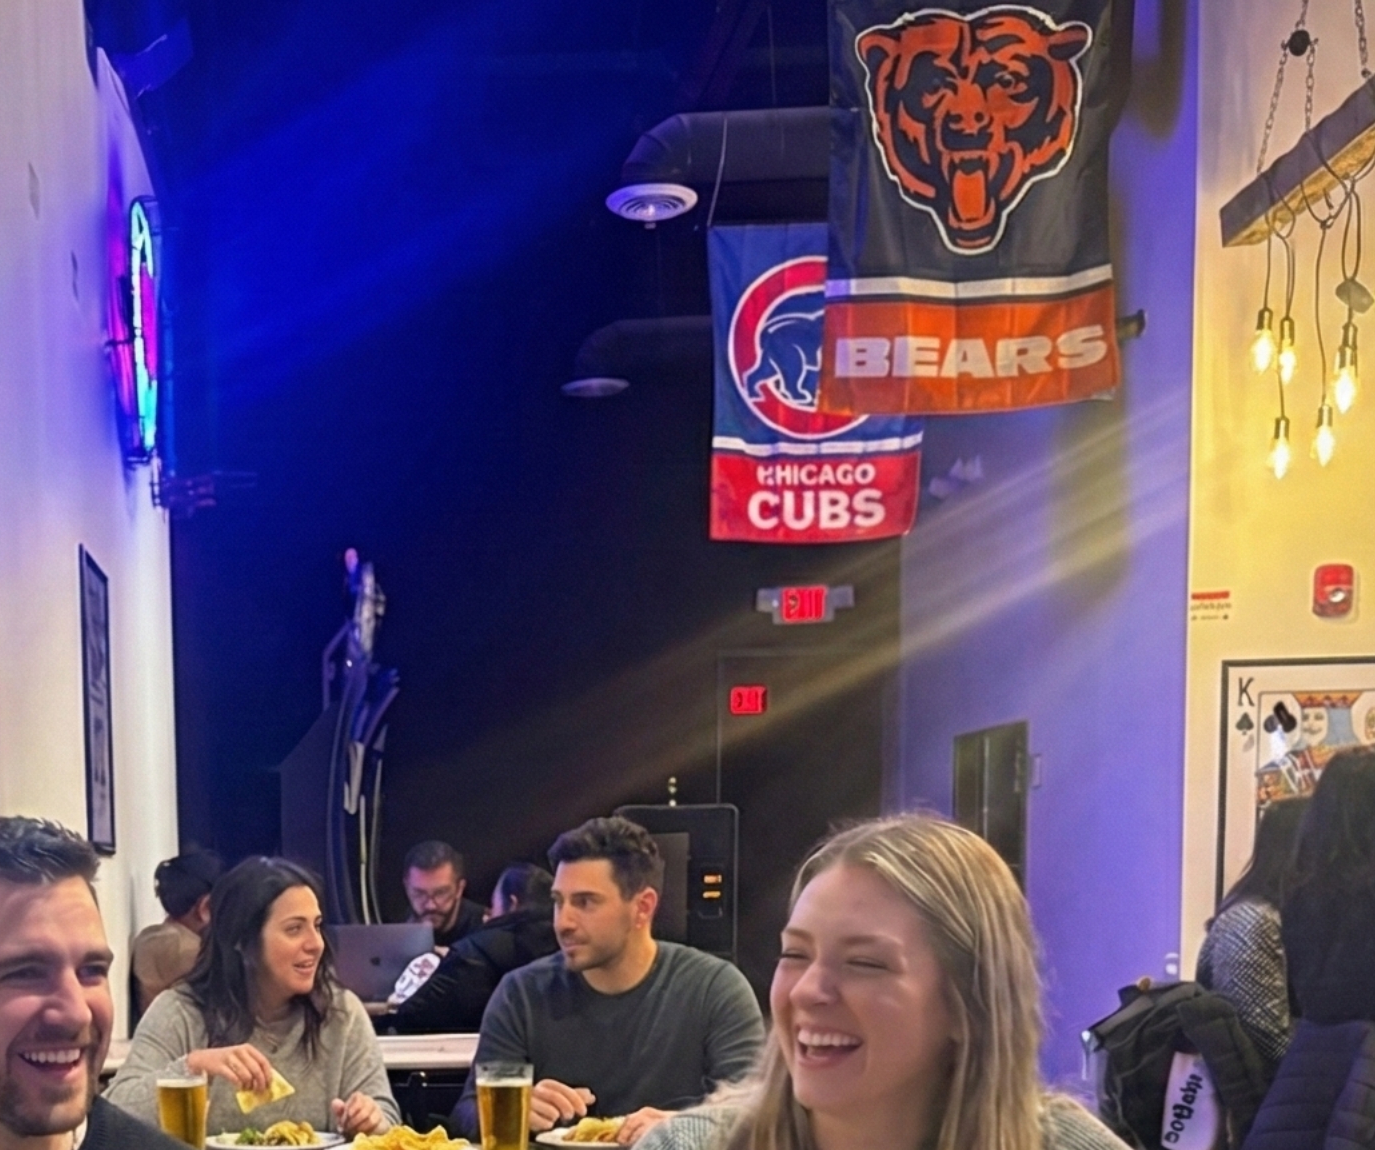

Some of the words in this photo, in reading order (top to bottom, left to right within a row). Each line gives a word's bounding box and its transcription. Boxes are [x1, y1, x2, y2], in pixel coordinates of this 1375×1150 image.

[835, 325, 1107, 378] BEARS
[747, 488, 886, 530] CUBS
[1238, 677, 1255, 707] K
